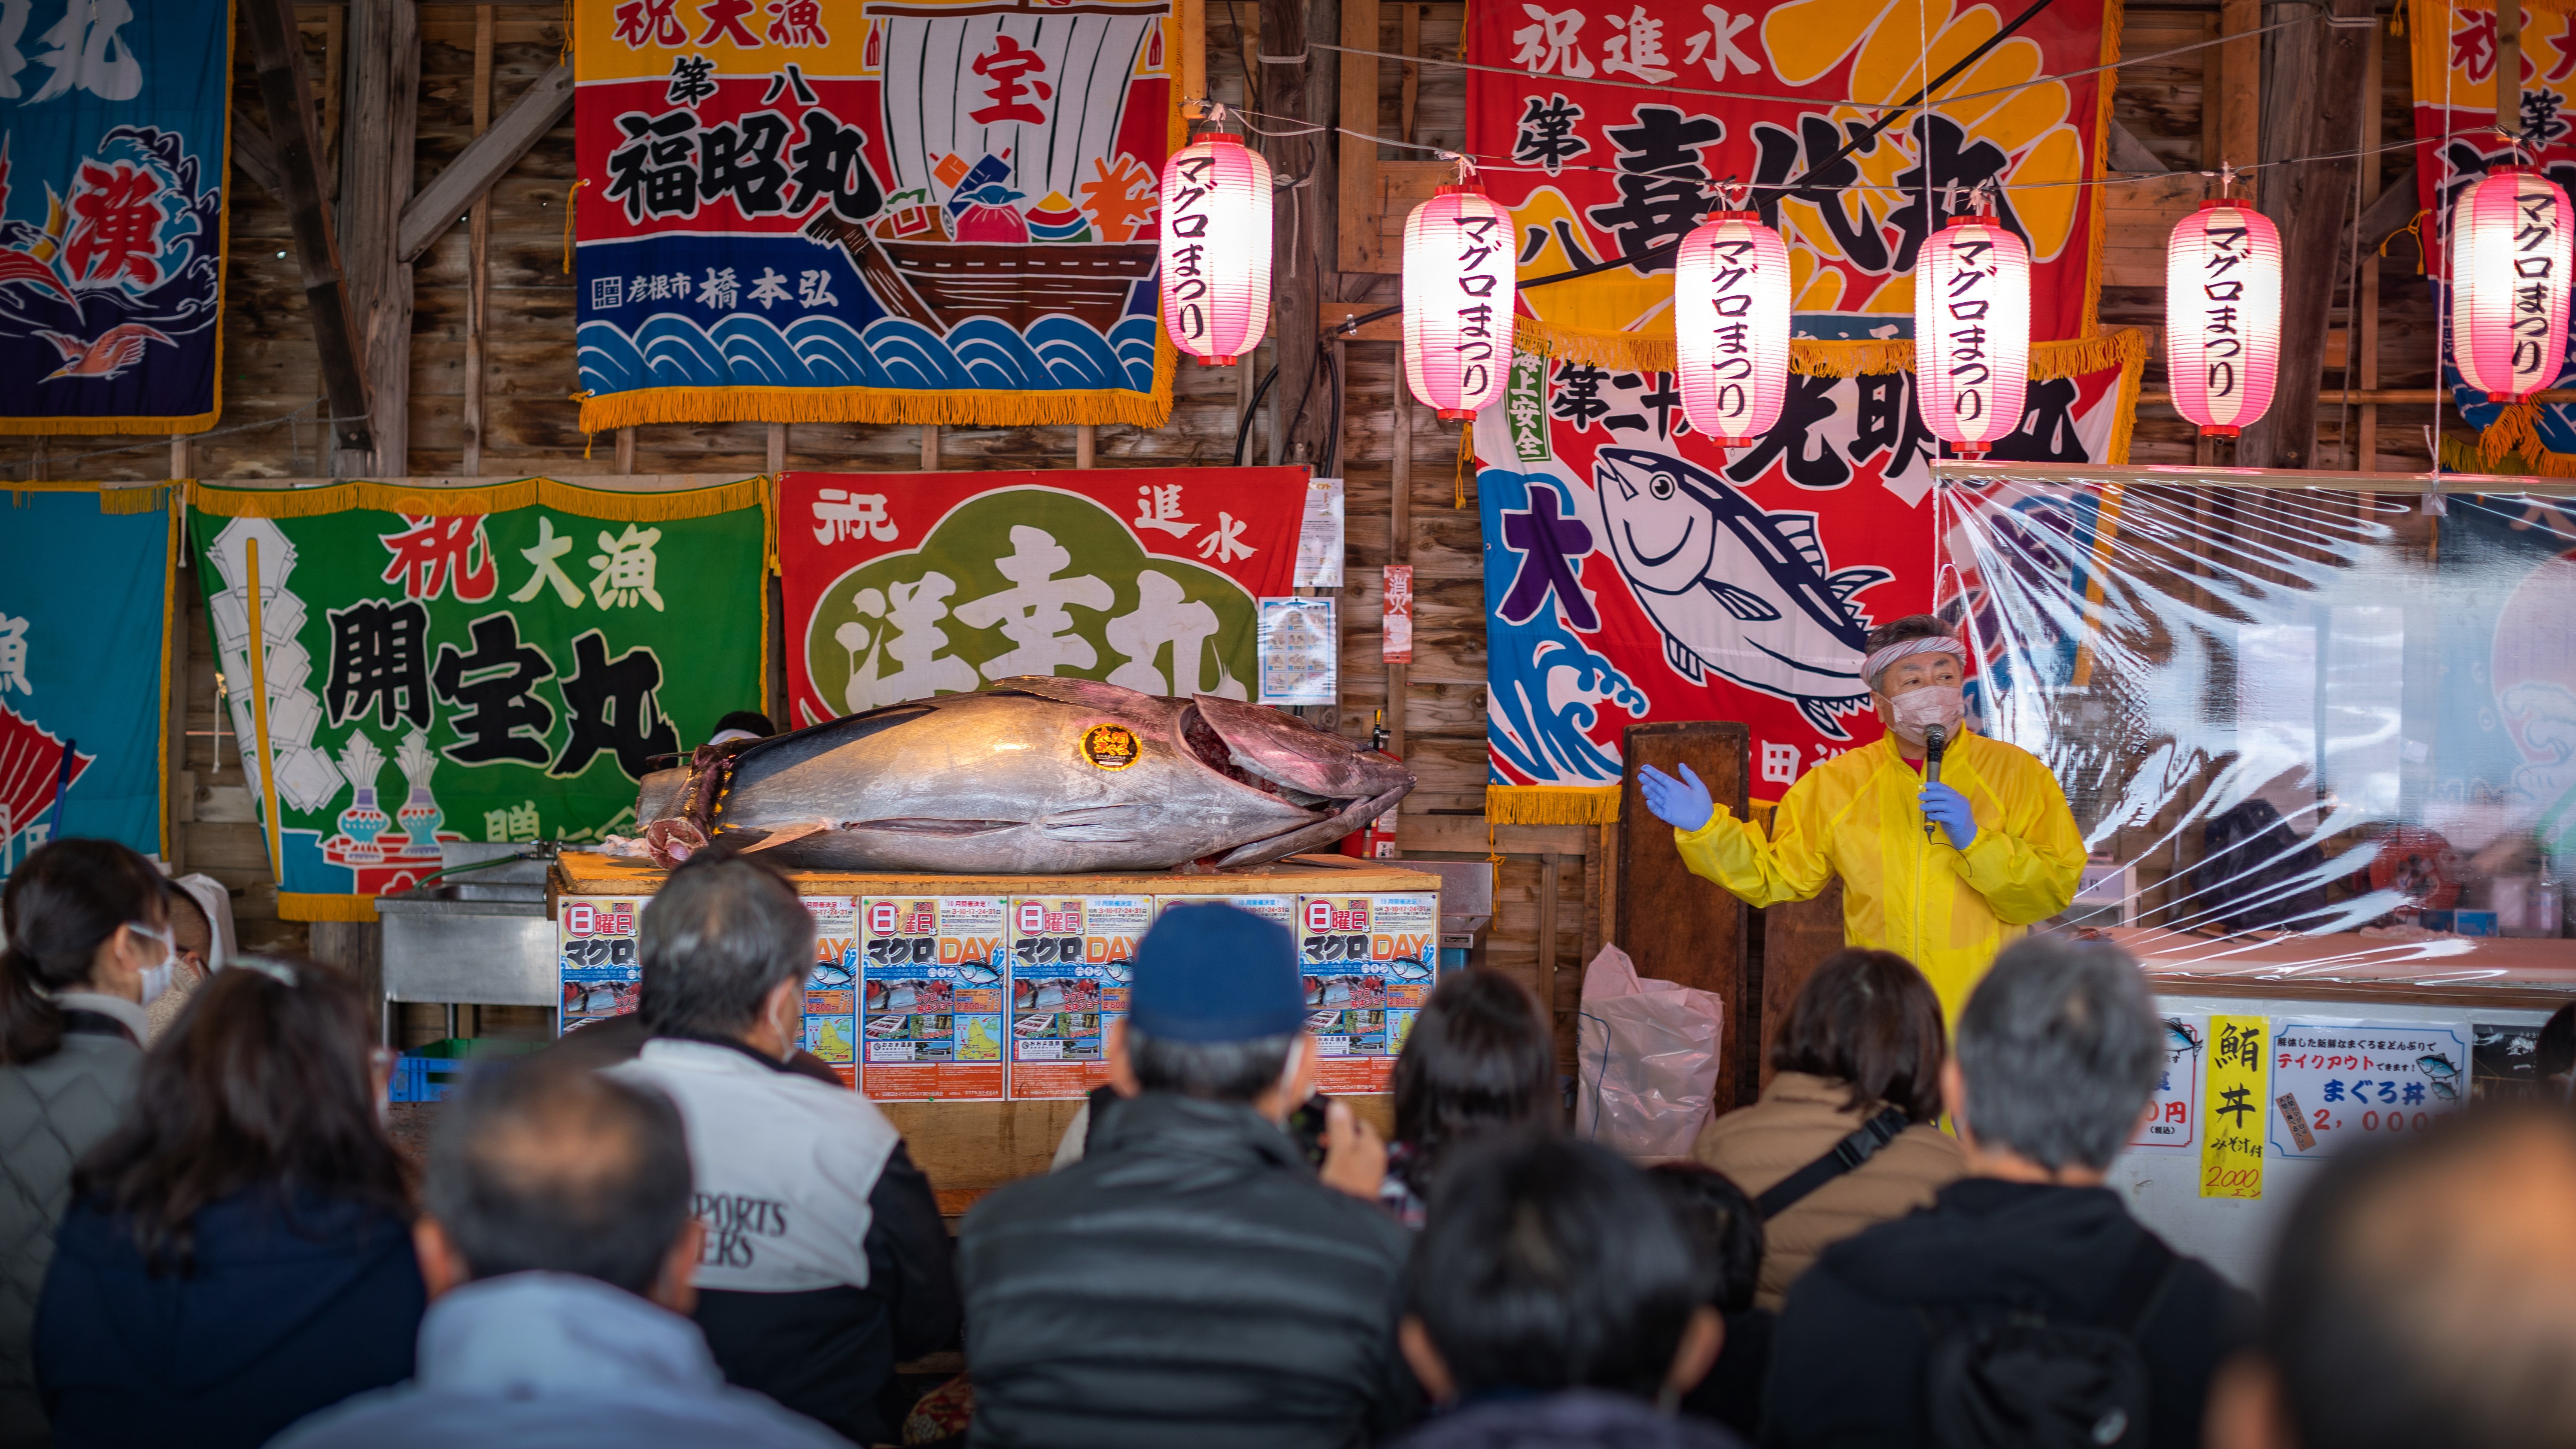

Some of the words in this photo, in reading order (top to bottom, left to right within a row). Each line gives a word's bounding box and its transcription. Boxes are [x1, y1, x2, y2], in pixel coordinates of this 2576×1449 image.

[0, 0, 143, 106] 丸
[614, 0, 829, 47] 祝大漁
[1511, 3, 1762, 84] 祝進水
[668, 56, 818, 106] 第八
[969, 35, 1052, 125] 宝
[606, 110, 884, 221] 福昭丸
[695, 267, 839, 310] 橋本弘
[1172, 156, 1218, 340] マグロまつり
[2509, 194, 2561, 374] マグロまつり
[1452, 216, 1500, 395] マグロまつり
[1710, 240, 1759, 419] マグロまつり
[1947, 240, 1998, 421] マグロまつり
[2203, 225, 2250, 397] マグロまつり
[1509, 348, 1544, 456] 海上安全
[1551, 359, 1693, 442] 第二十
[812, 488, 899, 546] 祝
[1133, 483, 1259, 564] 進水
[1500, 485, 1594, 630] 大
[1388, 577, 1408, 633] 消火器
[614, 994, 638, 1006] マグロ
[915, 992, 939, 1004] マグロ
[1063, 991, 1085, 1002] マグロ
[1349, 987, 1371, 999] マグロ
[2214, 1022, 2260, 1129] 鮪丼
[2323, 1079, 2426, 1106] まぐろ丼
[2205, 1166, 2259, 1188] 2000
